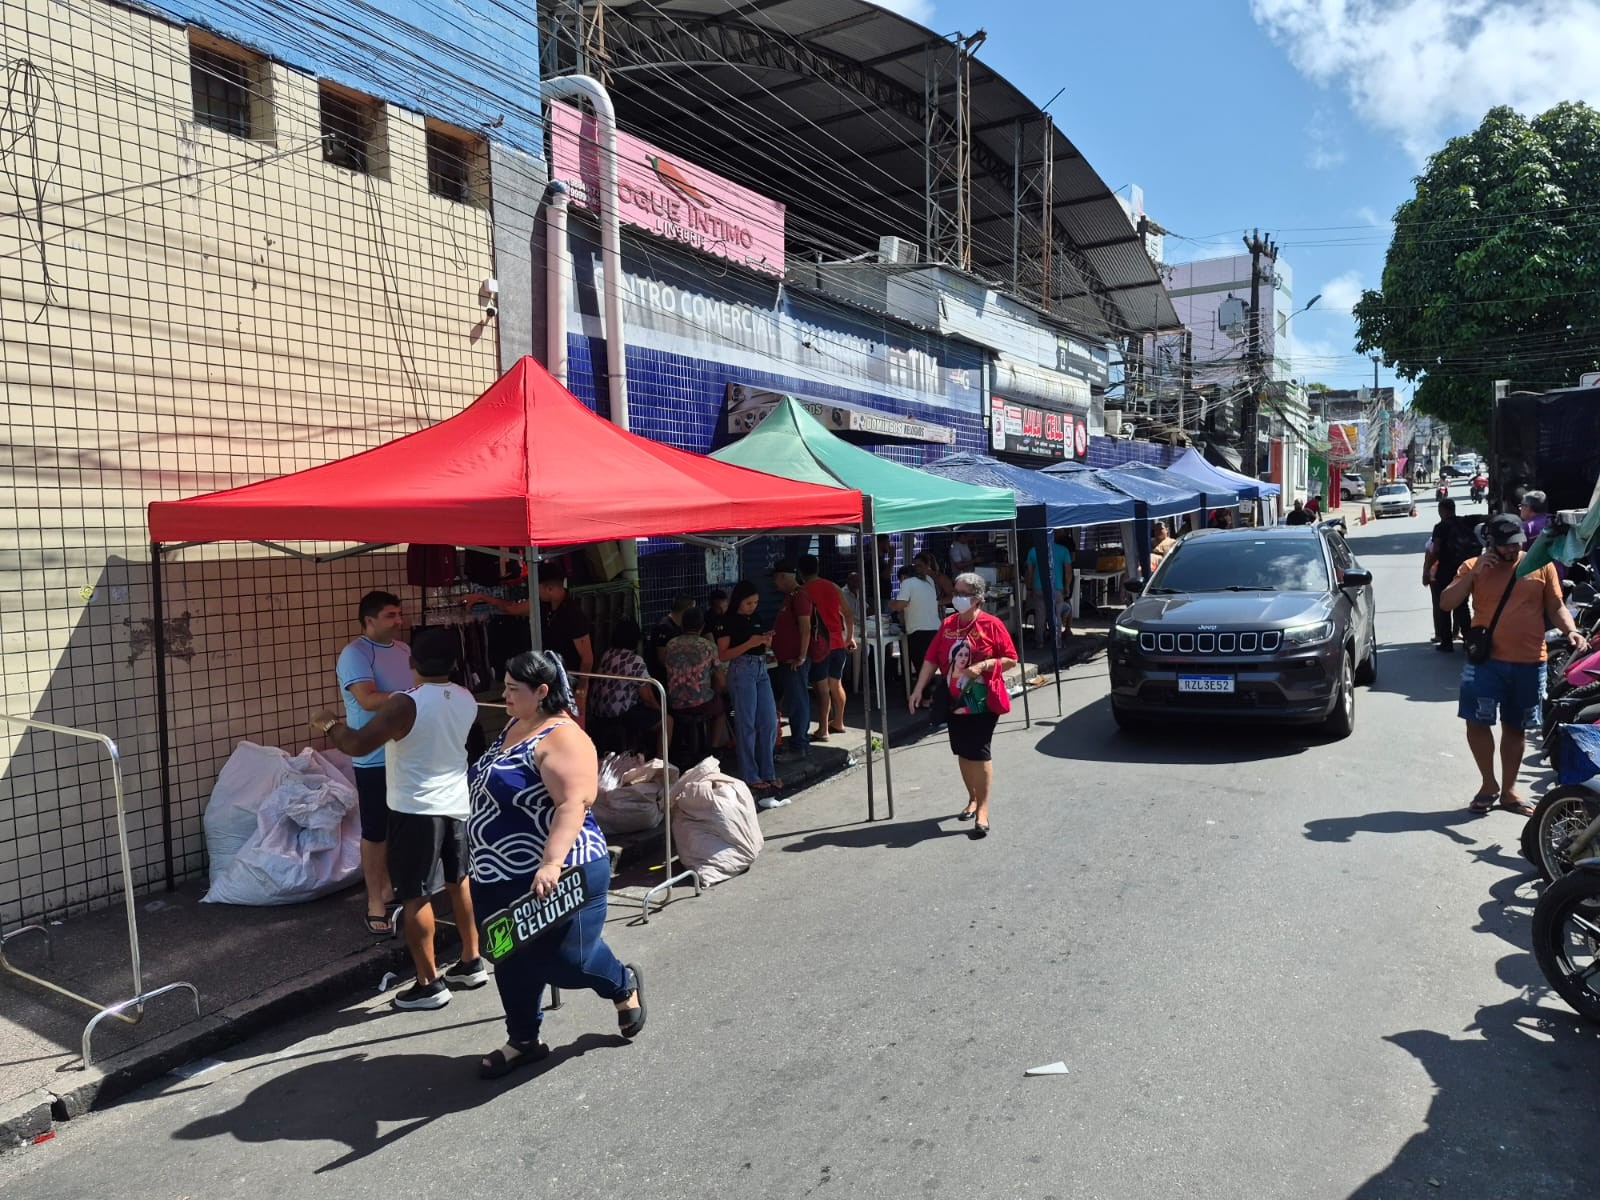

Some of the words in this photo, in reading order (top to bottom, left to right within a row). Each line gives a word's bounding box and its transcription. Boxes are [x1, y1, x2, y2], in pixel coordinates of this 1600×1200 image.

[680, 294, 777, 338] COMERCIAL
[1184, 680, 1229, 690] RZL3E52
[517, 887, 585, 942] CELULAR
